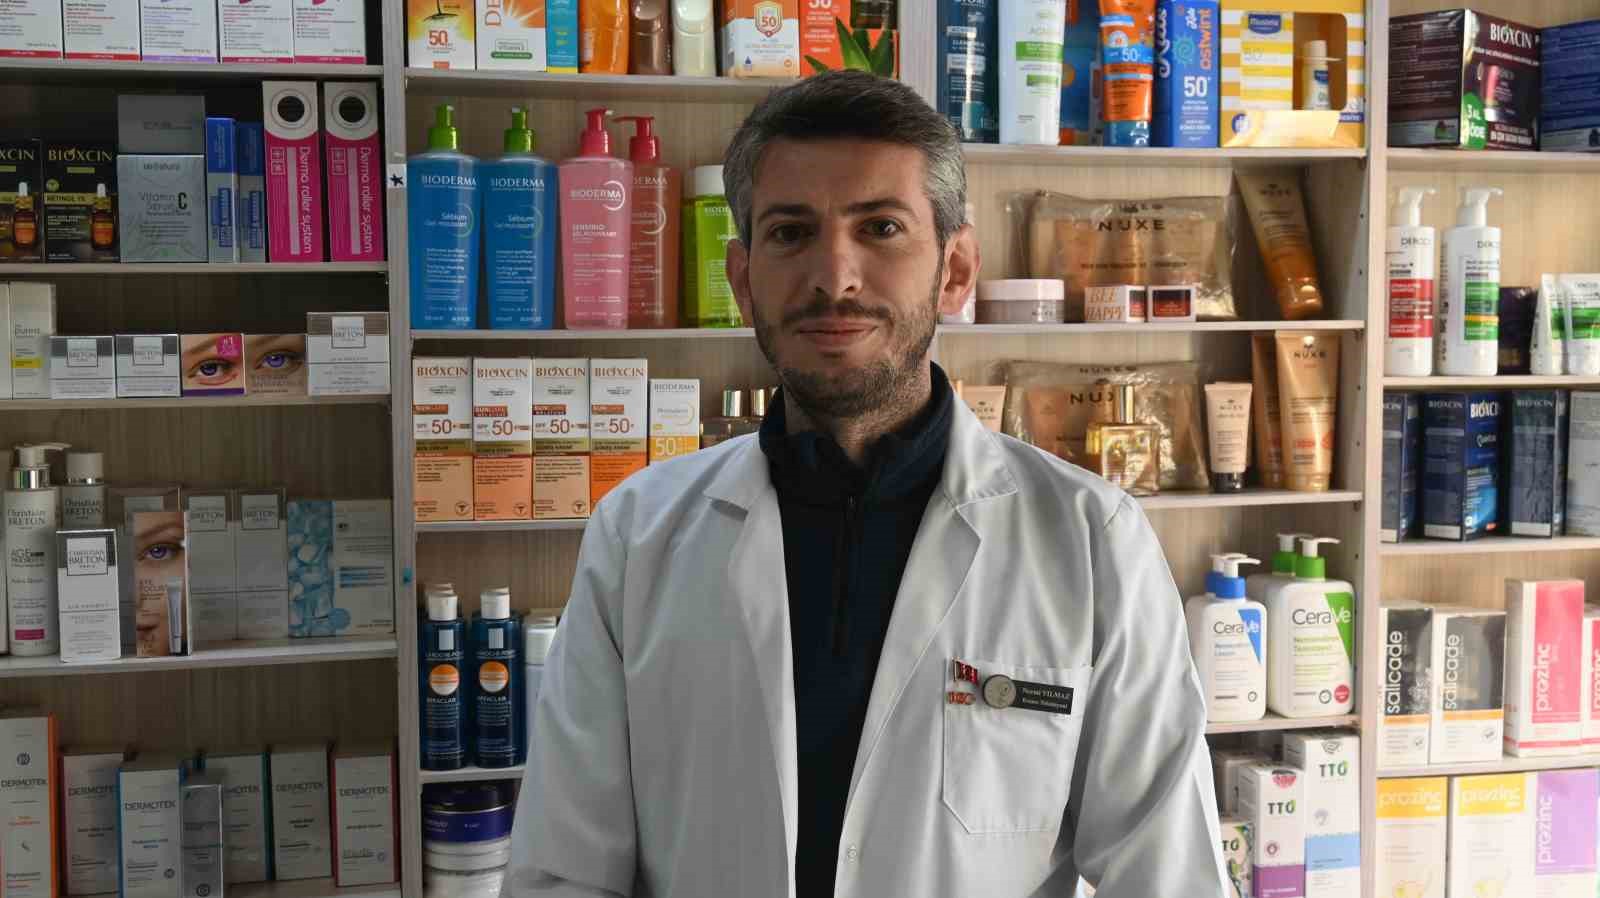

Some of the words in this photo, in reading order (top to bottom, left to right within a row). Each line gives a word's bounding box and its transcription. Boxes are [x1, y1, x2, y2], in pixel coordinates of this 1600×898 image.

[762, 16, 778, 27] 50
[428, 30, 448, 46] 50
[1489, 24, 1532, 48] BIOXCIN
[48, 147, 113, 162] BIOXCIN
[421, 175, 477, 186] BIODERMA
[490, 177, 545, 188] BIODERMA
[570, 188, 622, 199] BIODERMA
[178, 191, 188, 211] C
[1098, 219, 1168, 231] NUXE
[1294, 351, 1327, 359] NUXE
[416, 366, 469, 377] BIOXCIN
[477, 367, 528, 379] BIOXCIN
[535, 366, 586, 377] BIOXCIN
[594, 366, 645, 377] BIOXCIN
[654, 383, 696, 391] BIODERMA
[8, 508, 46, 517] Christian
[8, 516, 46, 526] BRETON
[69, 555, 107, 564] BRETON
[1291, 606, 1352, 625] CeraVe
[1213, 620, 1261, 635] CeraVe
[1386, 630, 1403, 715] salicade
[1444, 633, 1460, 710] salicade
[1531, 641, 1553, 713] prozinc
[1, 777, 48, 789] DERMOTEK
[276, 782, 325, 793] DERMOTEK
[339, 785, 388, 797] DERMOTEK
[123, 800, 177, 811] DERMOTEK
[1536, 789, 1556, 865] prozinc
